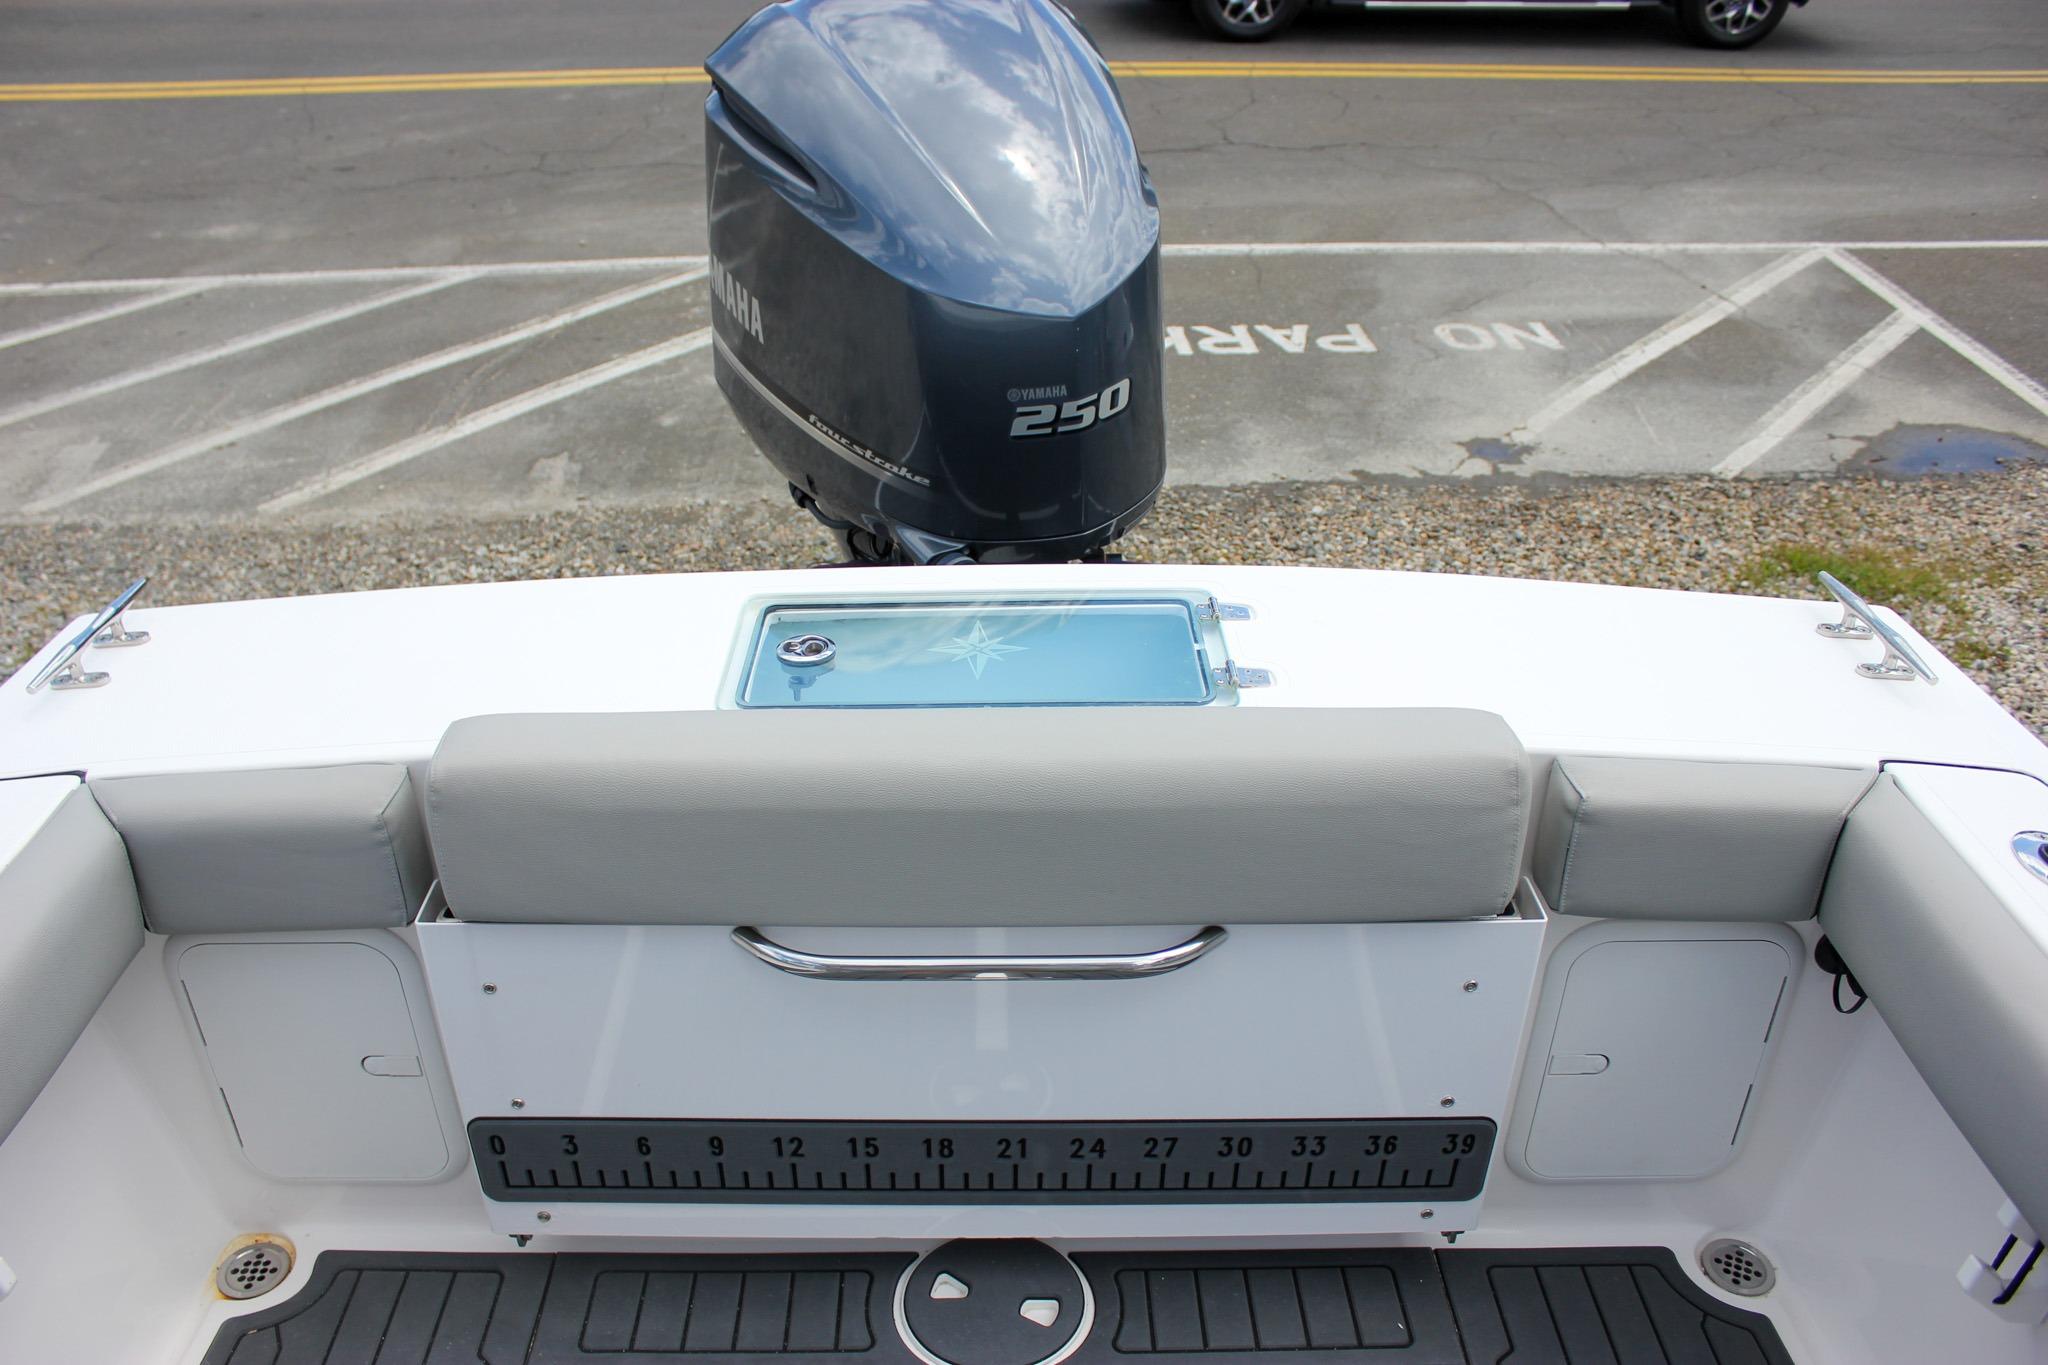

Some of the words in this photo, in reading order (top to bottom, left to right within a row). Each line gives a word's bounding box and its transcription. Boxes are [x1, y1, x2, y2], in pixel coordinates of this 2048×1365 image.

[1433, 321, 1565, 352] NO
[1021, 384, 1068, 401] YAMAHA
[1010, 378, 1130, 436] 250
[489, 1134, 506, 1156] 0
[561, 1134, 579, 1156] 3
[636, 1136, 652, 1156] 6
[708, 1136, 724, 1157] 9
[772, 1136, 805, 1158] 12
[847, 1137, 880, 1158] 15
[922, 1137, 955, 1159] 18
[996, 1137, 1027, 1159] 21
[1069, 1137, 1107, 1159] 24
[1143, 1136, 1179, 1159] 27
[1217, 1136, 1253, 1158] 30
[1290, 1135, 1327, 1157] 33
[1363, 1134, 1399, 1156] 36
[1441, 1133, 1476, 1155] 39
